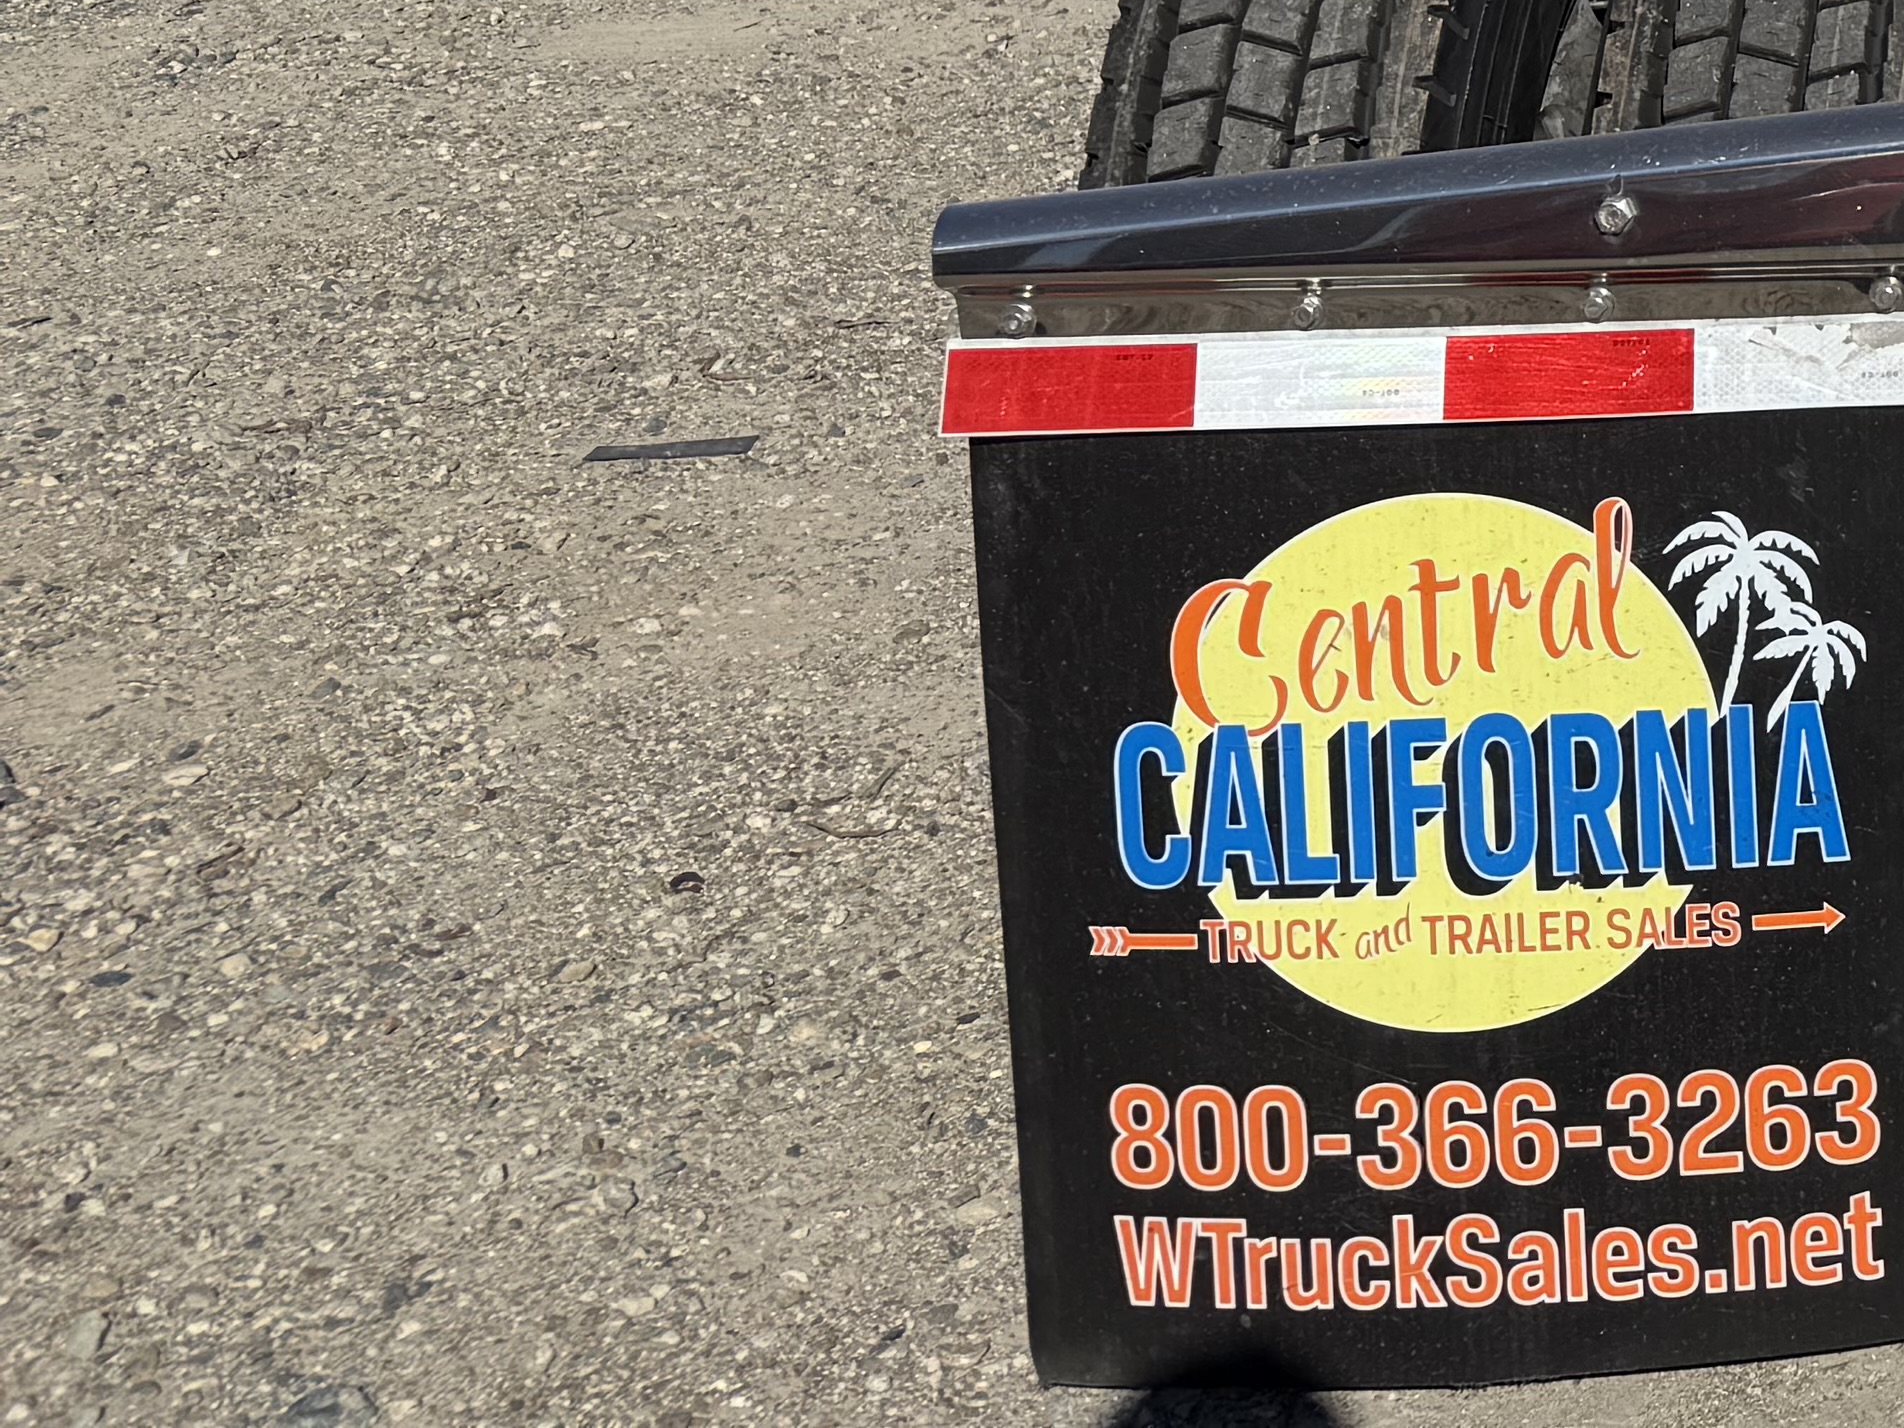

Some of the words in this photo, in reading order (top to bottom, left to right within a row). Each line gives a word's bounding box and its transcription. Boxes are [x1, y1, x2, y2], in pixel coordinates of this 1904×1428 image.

[1171, 495, 1642, 739] Central
[1113, 697, 1852, 892] CALIFORNIA
[1200, 916, 1340, 965] TRUCK
[1354, 911, 1413, 962] and
[1421, 907, 1593, 957] TRAILER
[1606, 899, 1743, 952] SALES
[1109, 1057, 1881, 1193] 800-366-3263
[1114, 1191, 1885, 1312] WTruckSales.net
